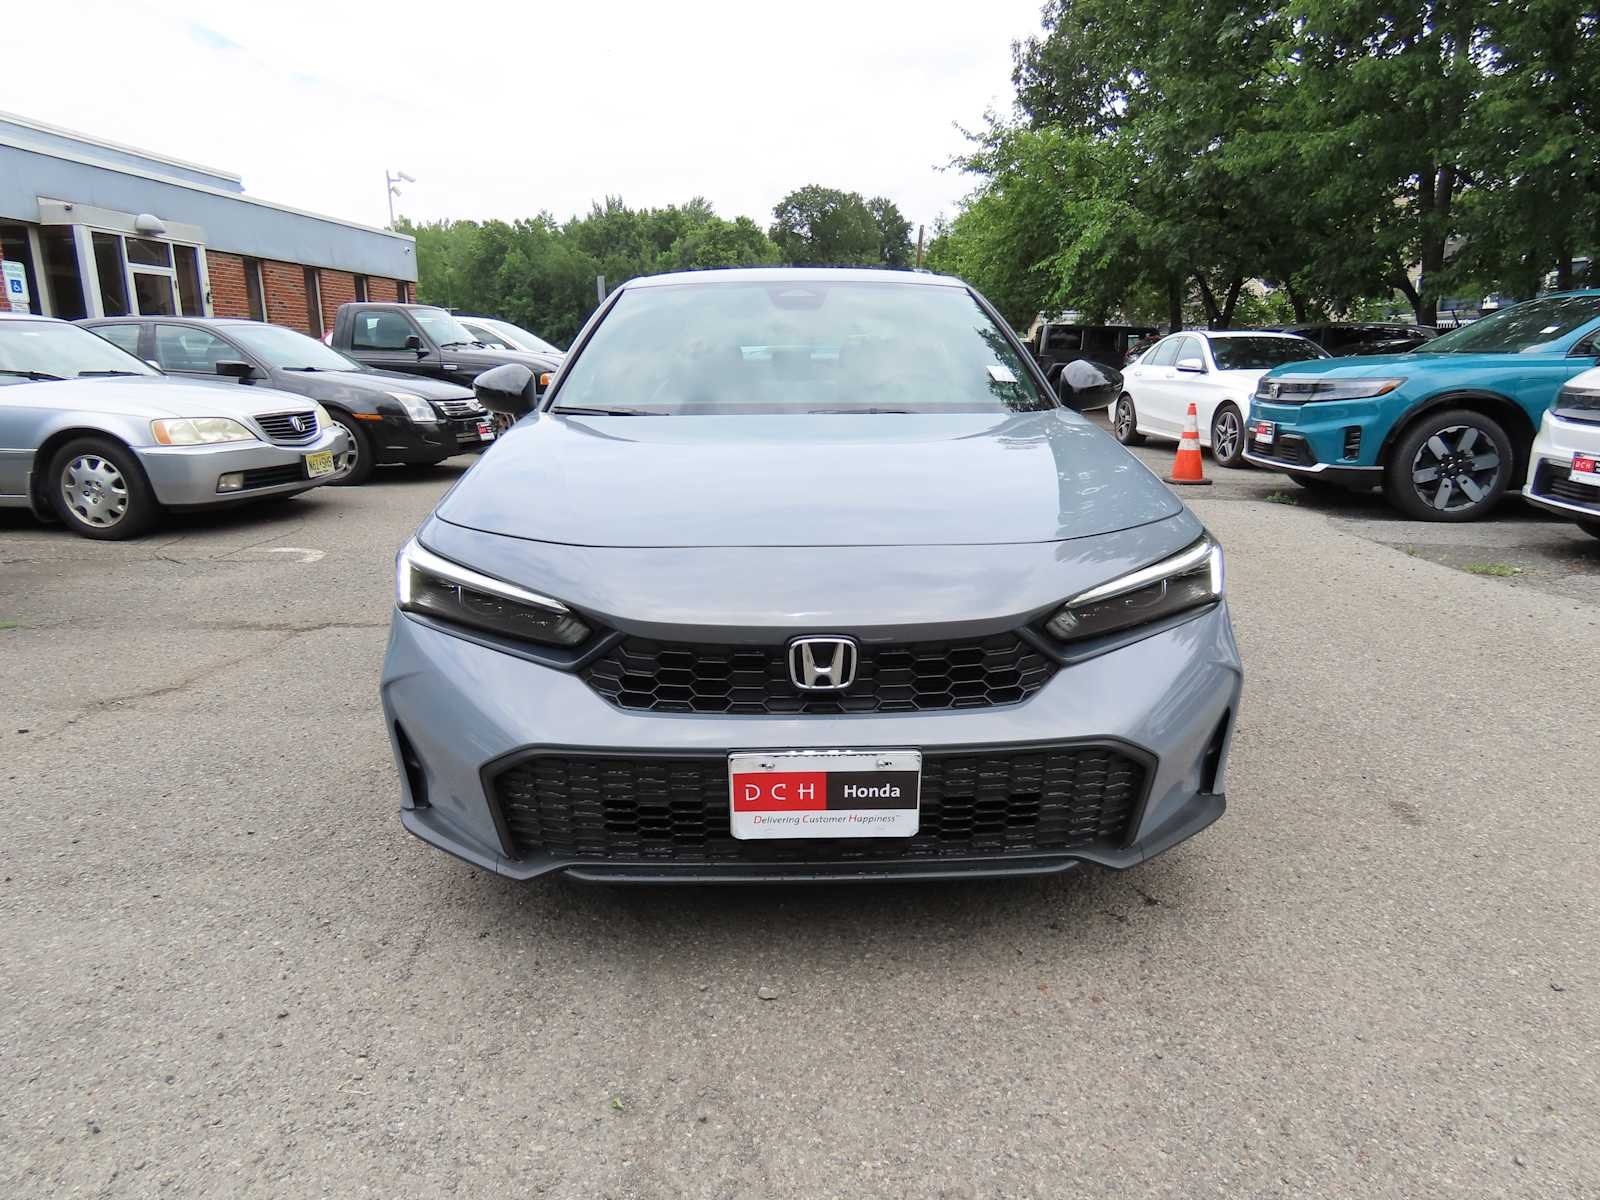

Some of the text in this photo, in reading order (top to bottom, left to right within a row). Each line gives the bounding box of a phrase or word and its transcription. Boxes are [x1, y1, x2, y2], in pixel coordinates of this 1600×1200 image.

[843, 783, 901, 799] Honda
[753, 815, 800, 826] Delivering
[802, 814, 847, 824] Customer
